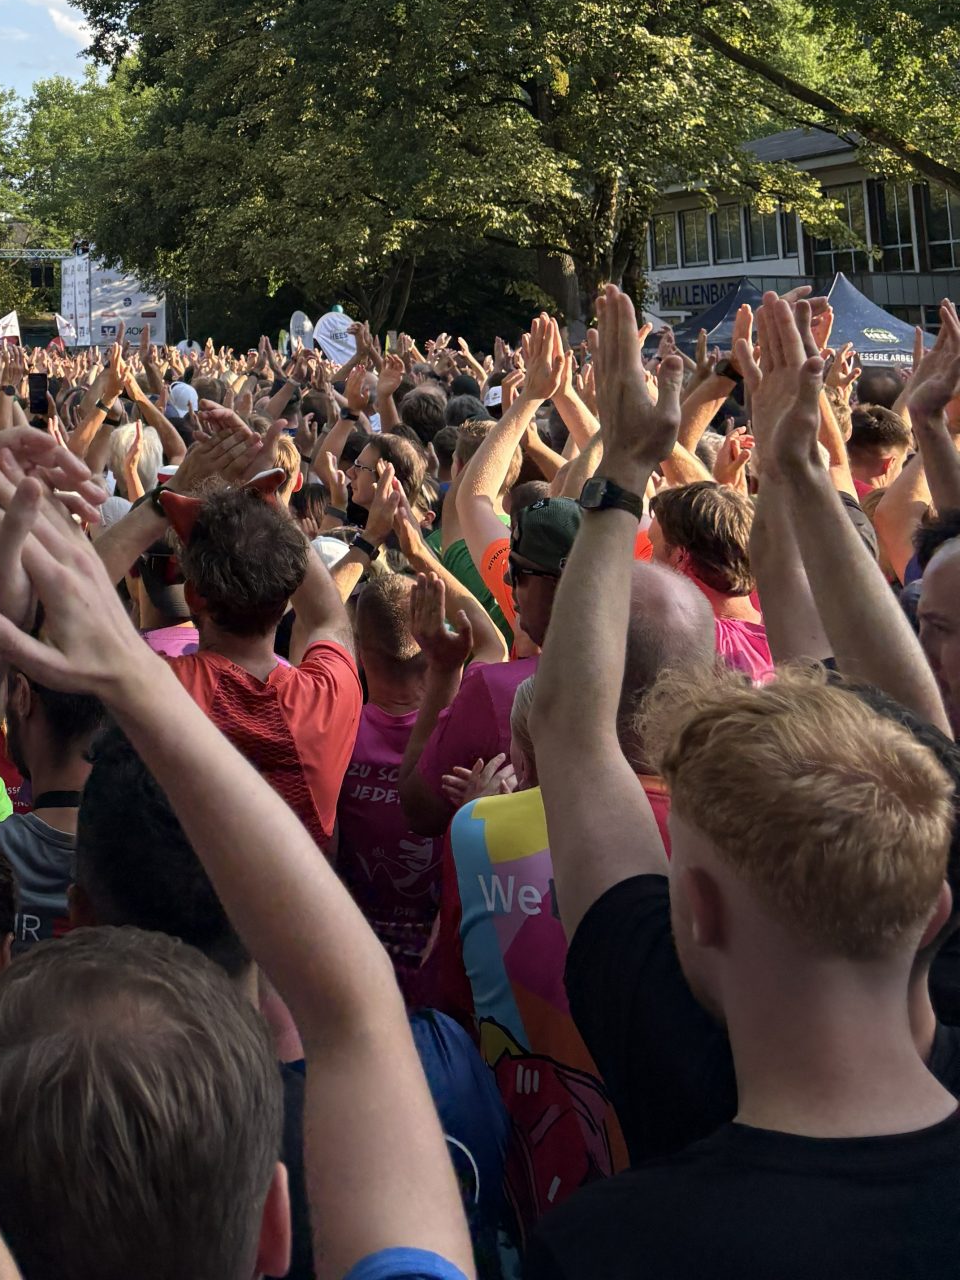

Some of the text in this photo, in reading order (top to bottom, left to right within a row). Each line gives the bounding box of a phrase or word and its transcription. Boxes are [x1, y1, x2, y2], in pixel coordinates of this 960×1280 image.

[858, 352, 889, 361] ESSERE
[347, 763, 372, 778] ZU
[350, 784, 400, 805] JEDE
[477, 873, 542, 916] We
